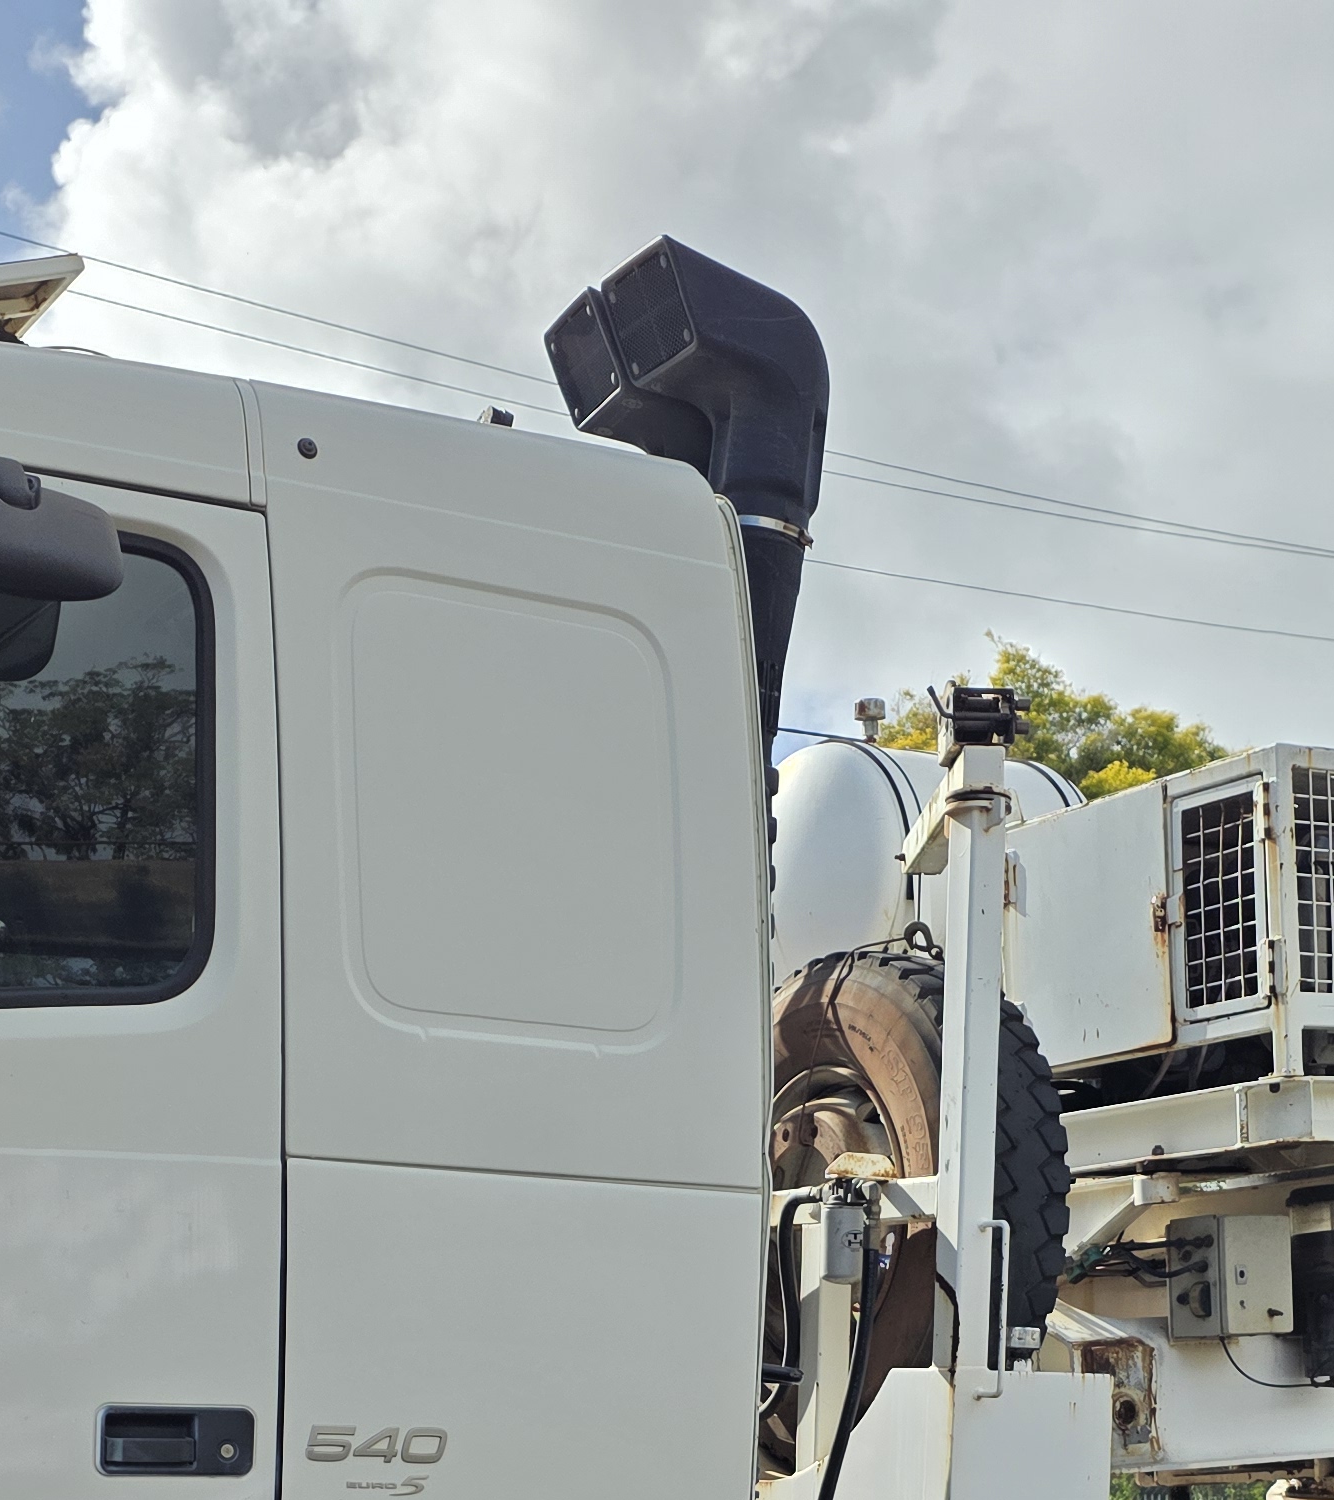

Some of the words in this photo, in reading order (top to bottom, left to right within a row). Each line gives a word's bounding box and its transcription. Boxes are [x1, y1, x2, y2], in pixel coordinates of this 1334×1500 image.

[304, 1423, 448, 1464] 540
[345, 1480, 397, 1490] EURO
[389, 1474, 429, 1497] 5
